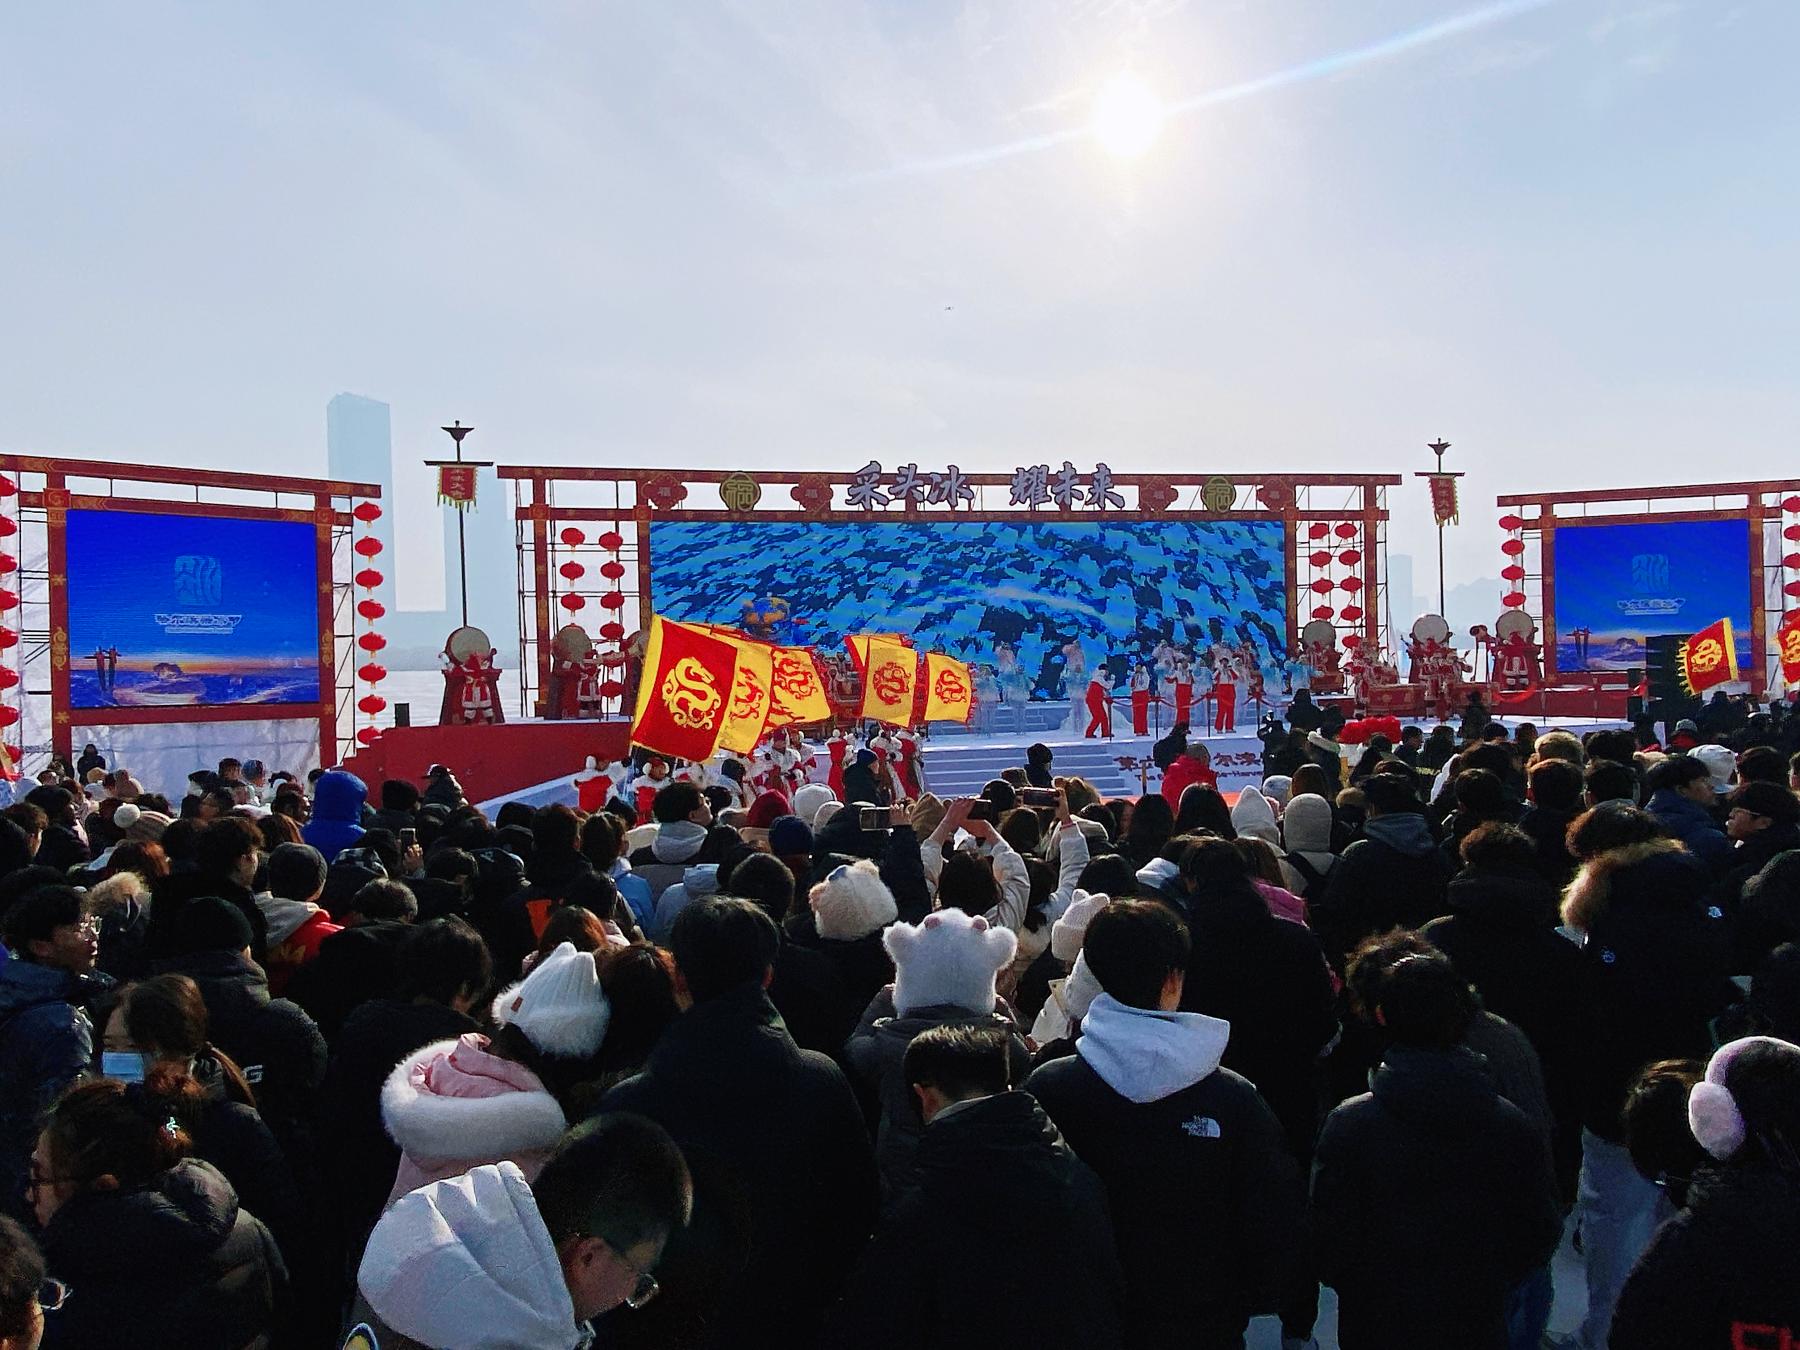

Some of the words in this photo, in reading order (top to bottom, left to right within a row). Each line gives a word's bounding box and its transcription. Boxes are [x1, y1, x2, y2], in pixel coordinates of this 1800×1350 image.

[845, 461, 974, 510] 采头冰
[1010, 461, 1126, 509] 耀未来
